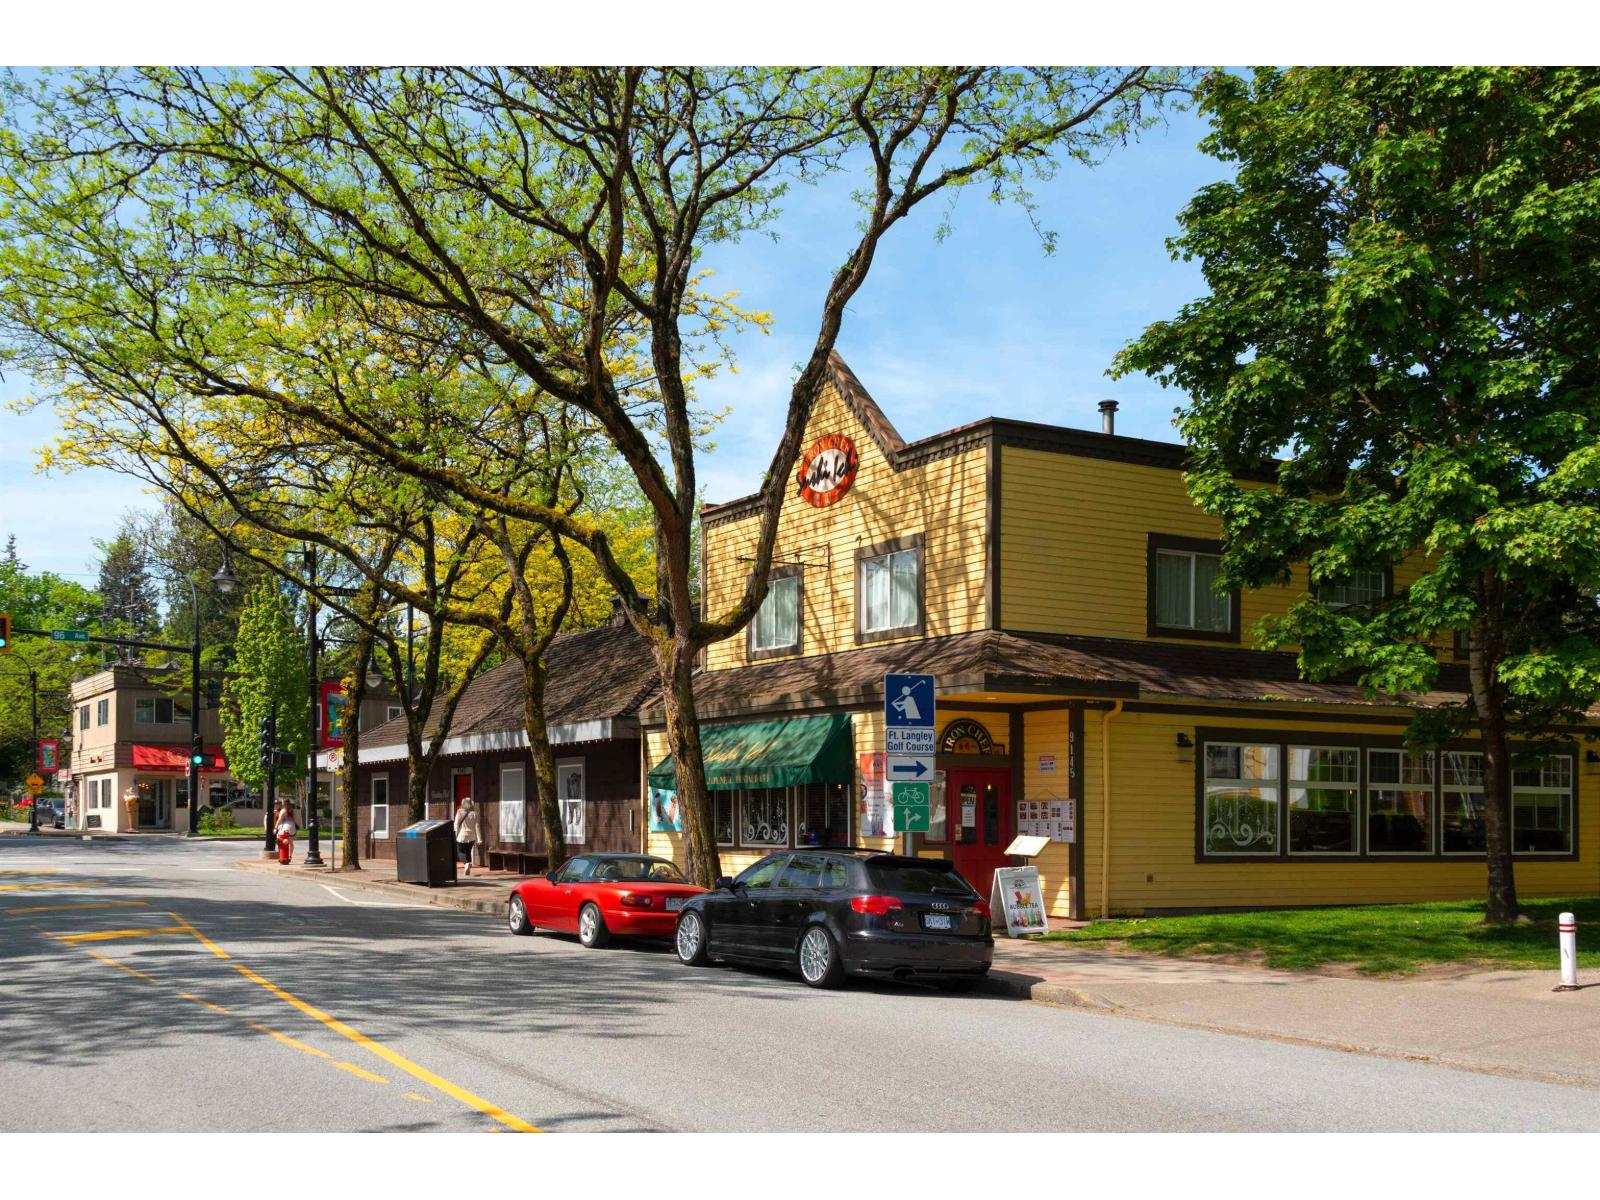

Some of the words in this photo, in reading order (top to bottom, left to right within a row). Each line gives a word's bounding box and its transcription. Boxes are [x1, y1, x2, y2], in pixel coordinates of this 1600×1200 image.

[53, 630, 65, 640] 96
[889, 730, 899, 741] Ft.
[901, 730, 933, 743] Langley
[944, 726, 966, 752] IRON
[887, 741, 904, 751] Golf
[905, 741, 934, 752] Course
